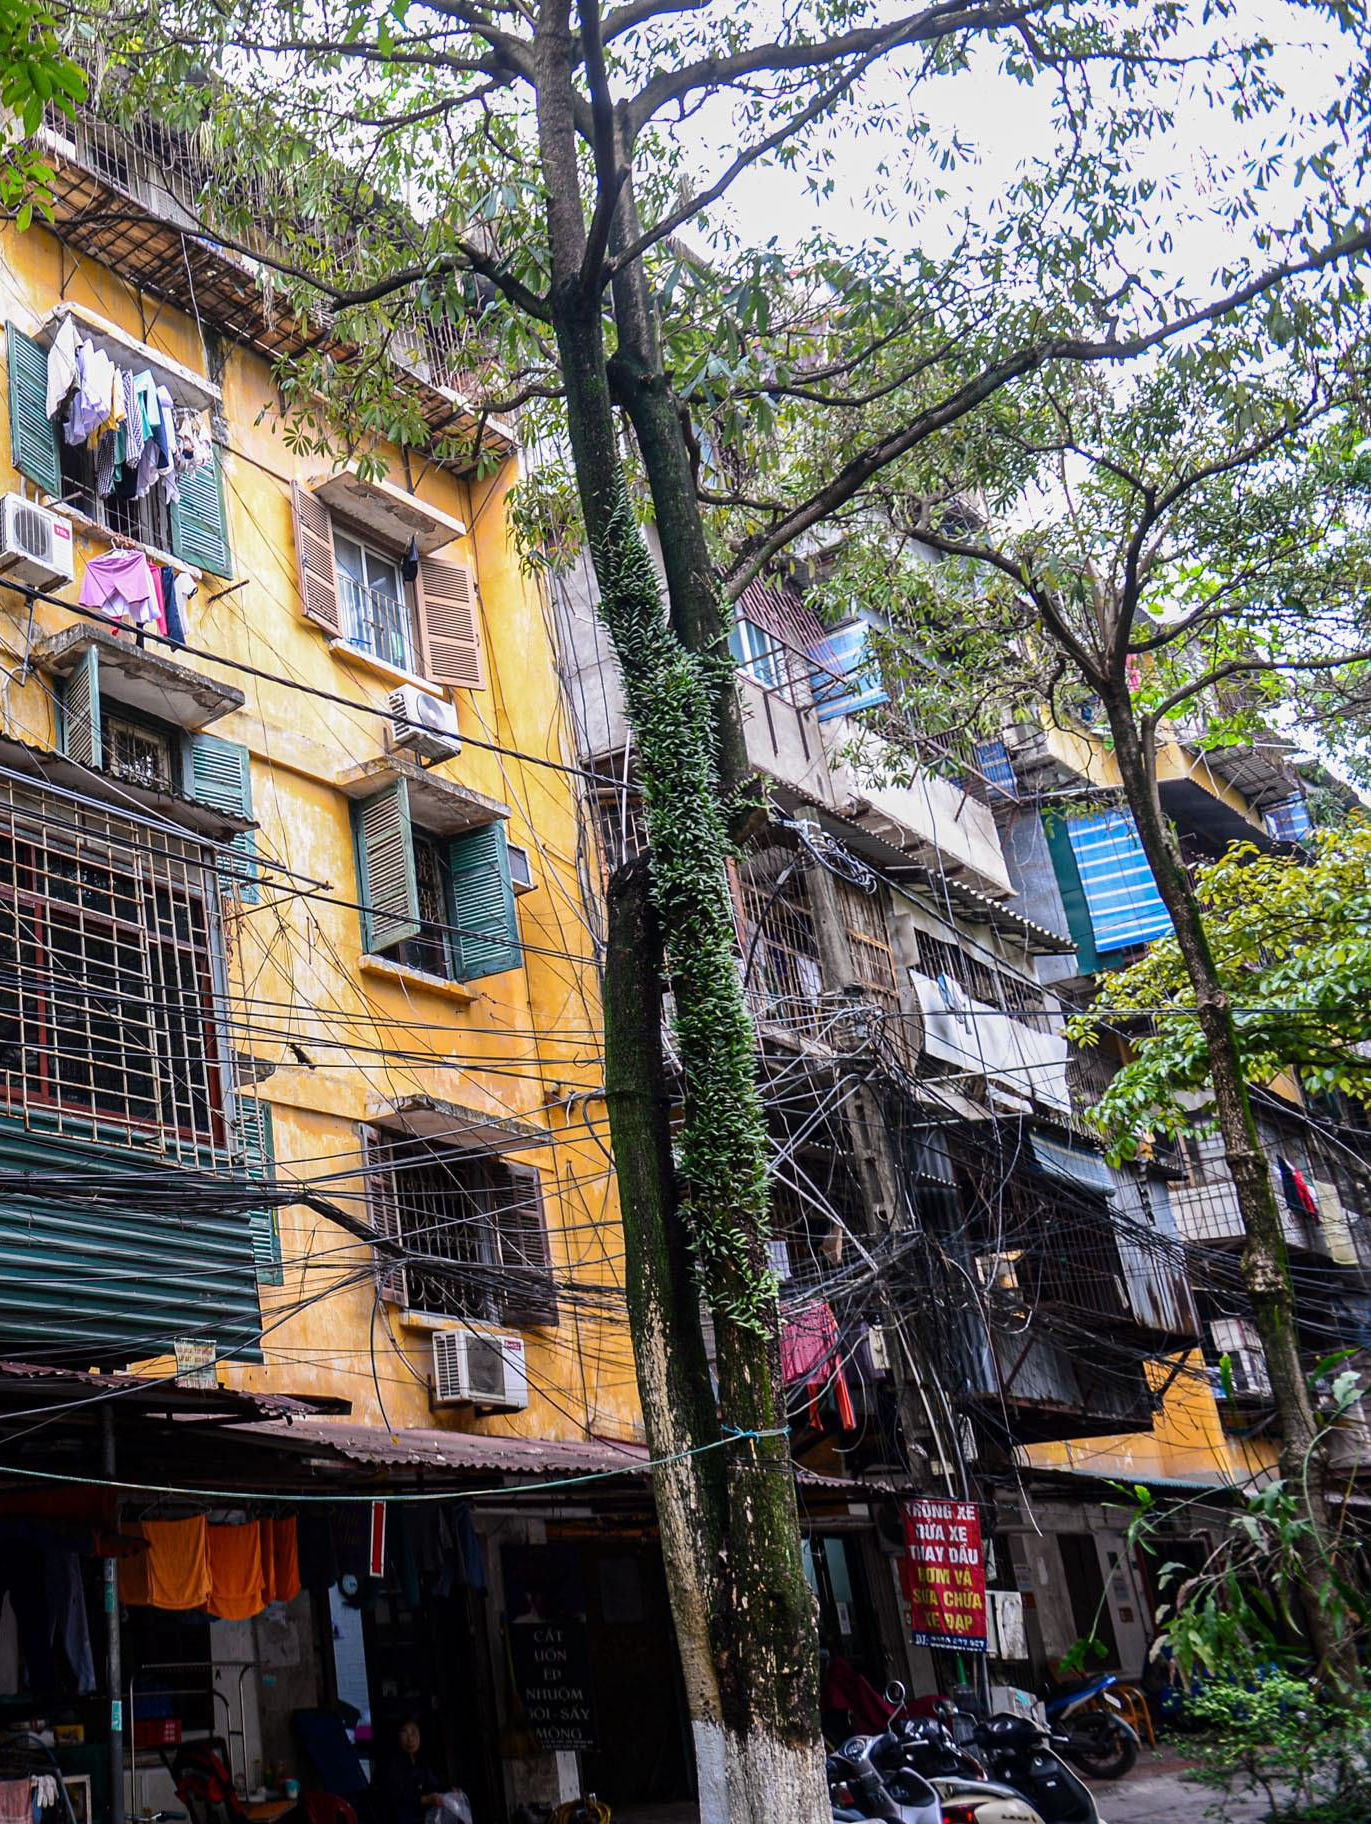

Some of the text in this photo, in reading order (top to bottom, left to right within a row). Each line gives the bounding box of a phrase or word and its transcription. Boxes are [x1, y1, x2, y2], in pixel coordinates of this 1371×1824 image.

[957, 1505, 977, 1520] XE
[949, 1525, 969, 1543] XE
[909, 1543, 979, 1565] THAY DẦU
[943, 1588, 983, 1609] CHỮA
[943, 1611, 974, 1633] ĐẠP
[526, 1685, 583, 1701] NHUỘM
